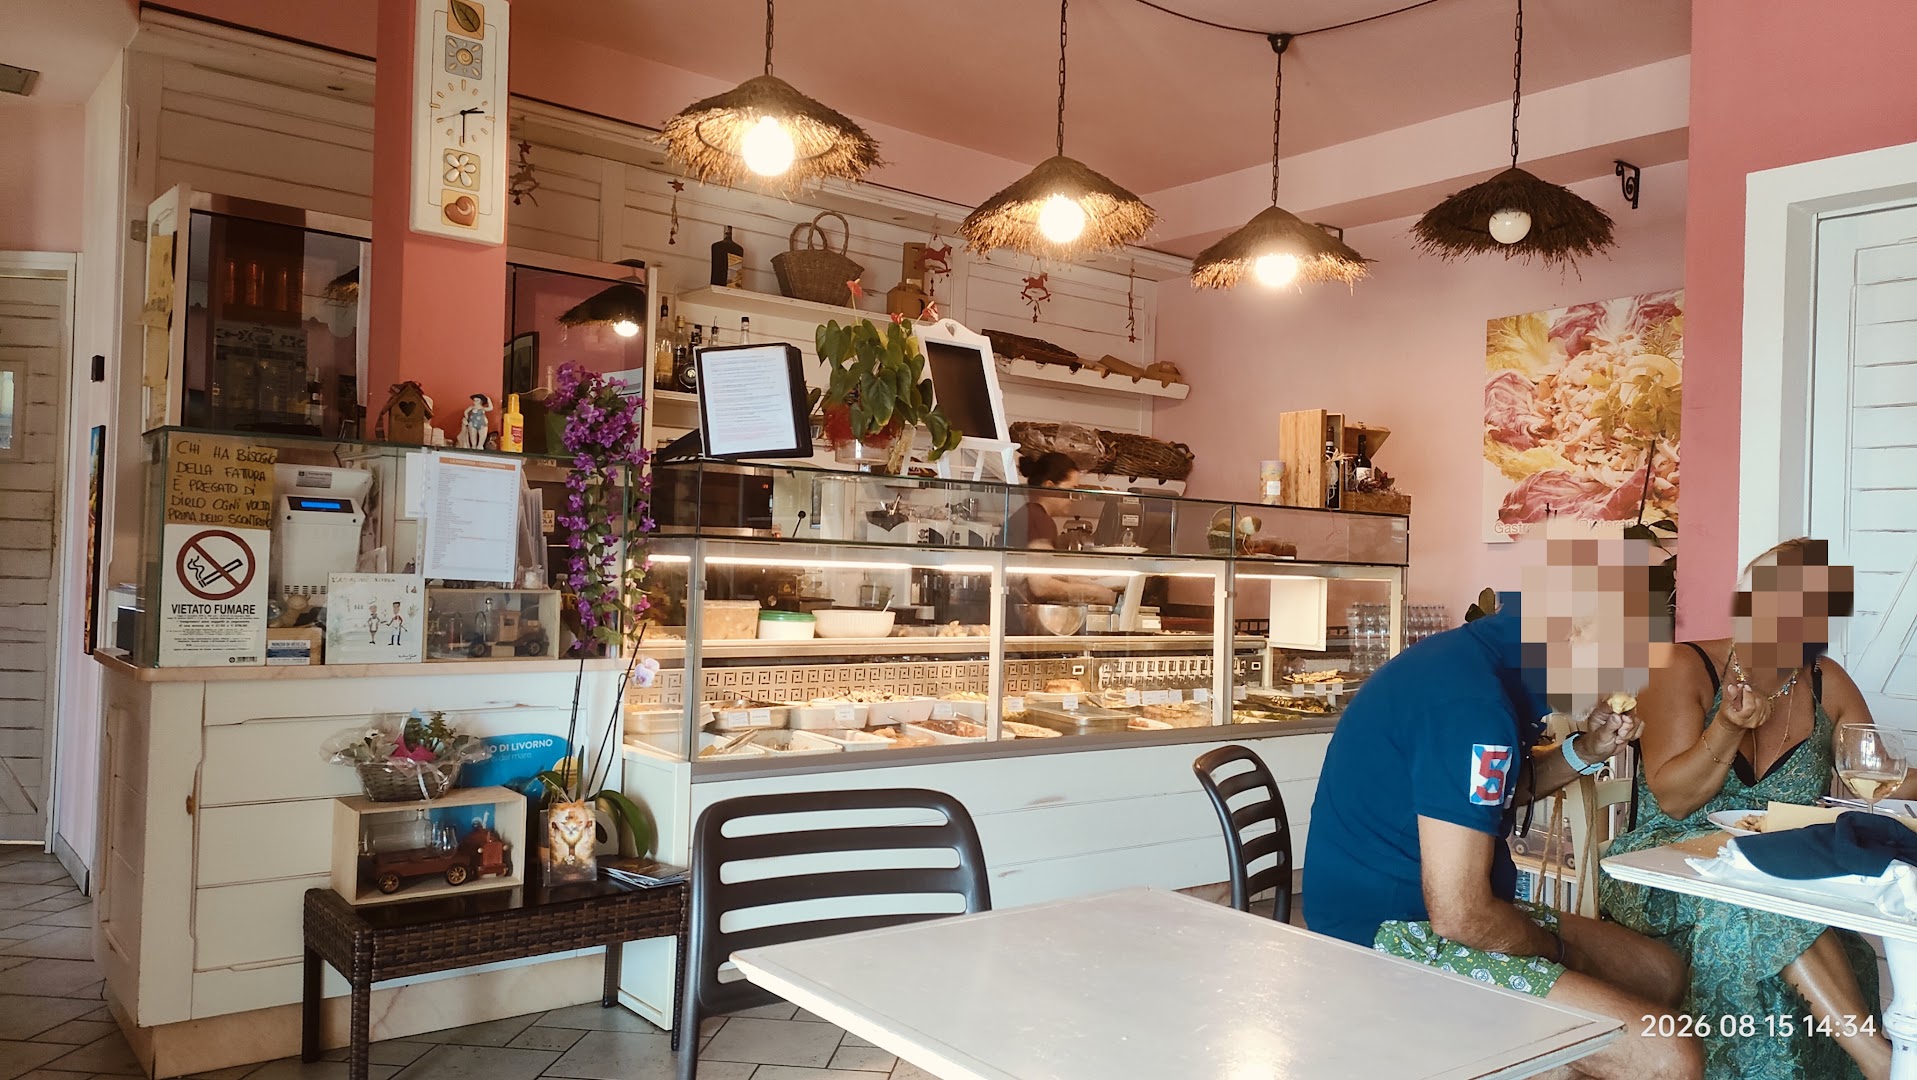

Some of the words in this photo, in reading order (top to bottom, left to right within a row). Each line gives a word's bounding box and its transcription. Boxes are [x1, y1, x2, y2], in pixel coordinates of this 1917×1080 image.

[177, 440, 200, 455] CHI
[213, 445, 230, 460] HA
[236, 446, 277, 465] BISOGNO
[176, 462, 213, 476] DELLA
[224, 467, 266, 482] FATTURA
[189, 480, 238, 494] PREGATO
[171, 492, 206, 509] DIRLO
[213, 497, 241, 511] OGNI
[246, 500, 271, 511] VOLTA
[168, 508, 196, 522] PRIMA
[200, 513, 223, 523] DELLO
[228, 513, 271, 528] SCONTRINO
[171, 604, 212, 615] VIETATO
[214, 604, 256, 615] FUMARE
[499, 744, 509, 752] DI
[511, 738, 553, 751] LIVORNO
[511, 752, 532, 760] mare
[1476, 751, 1508, 801] 5
